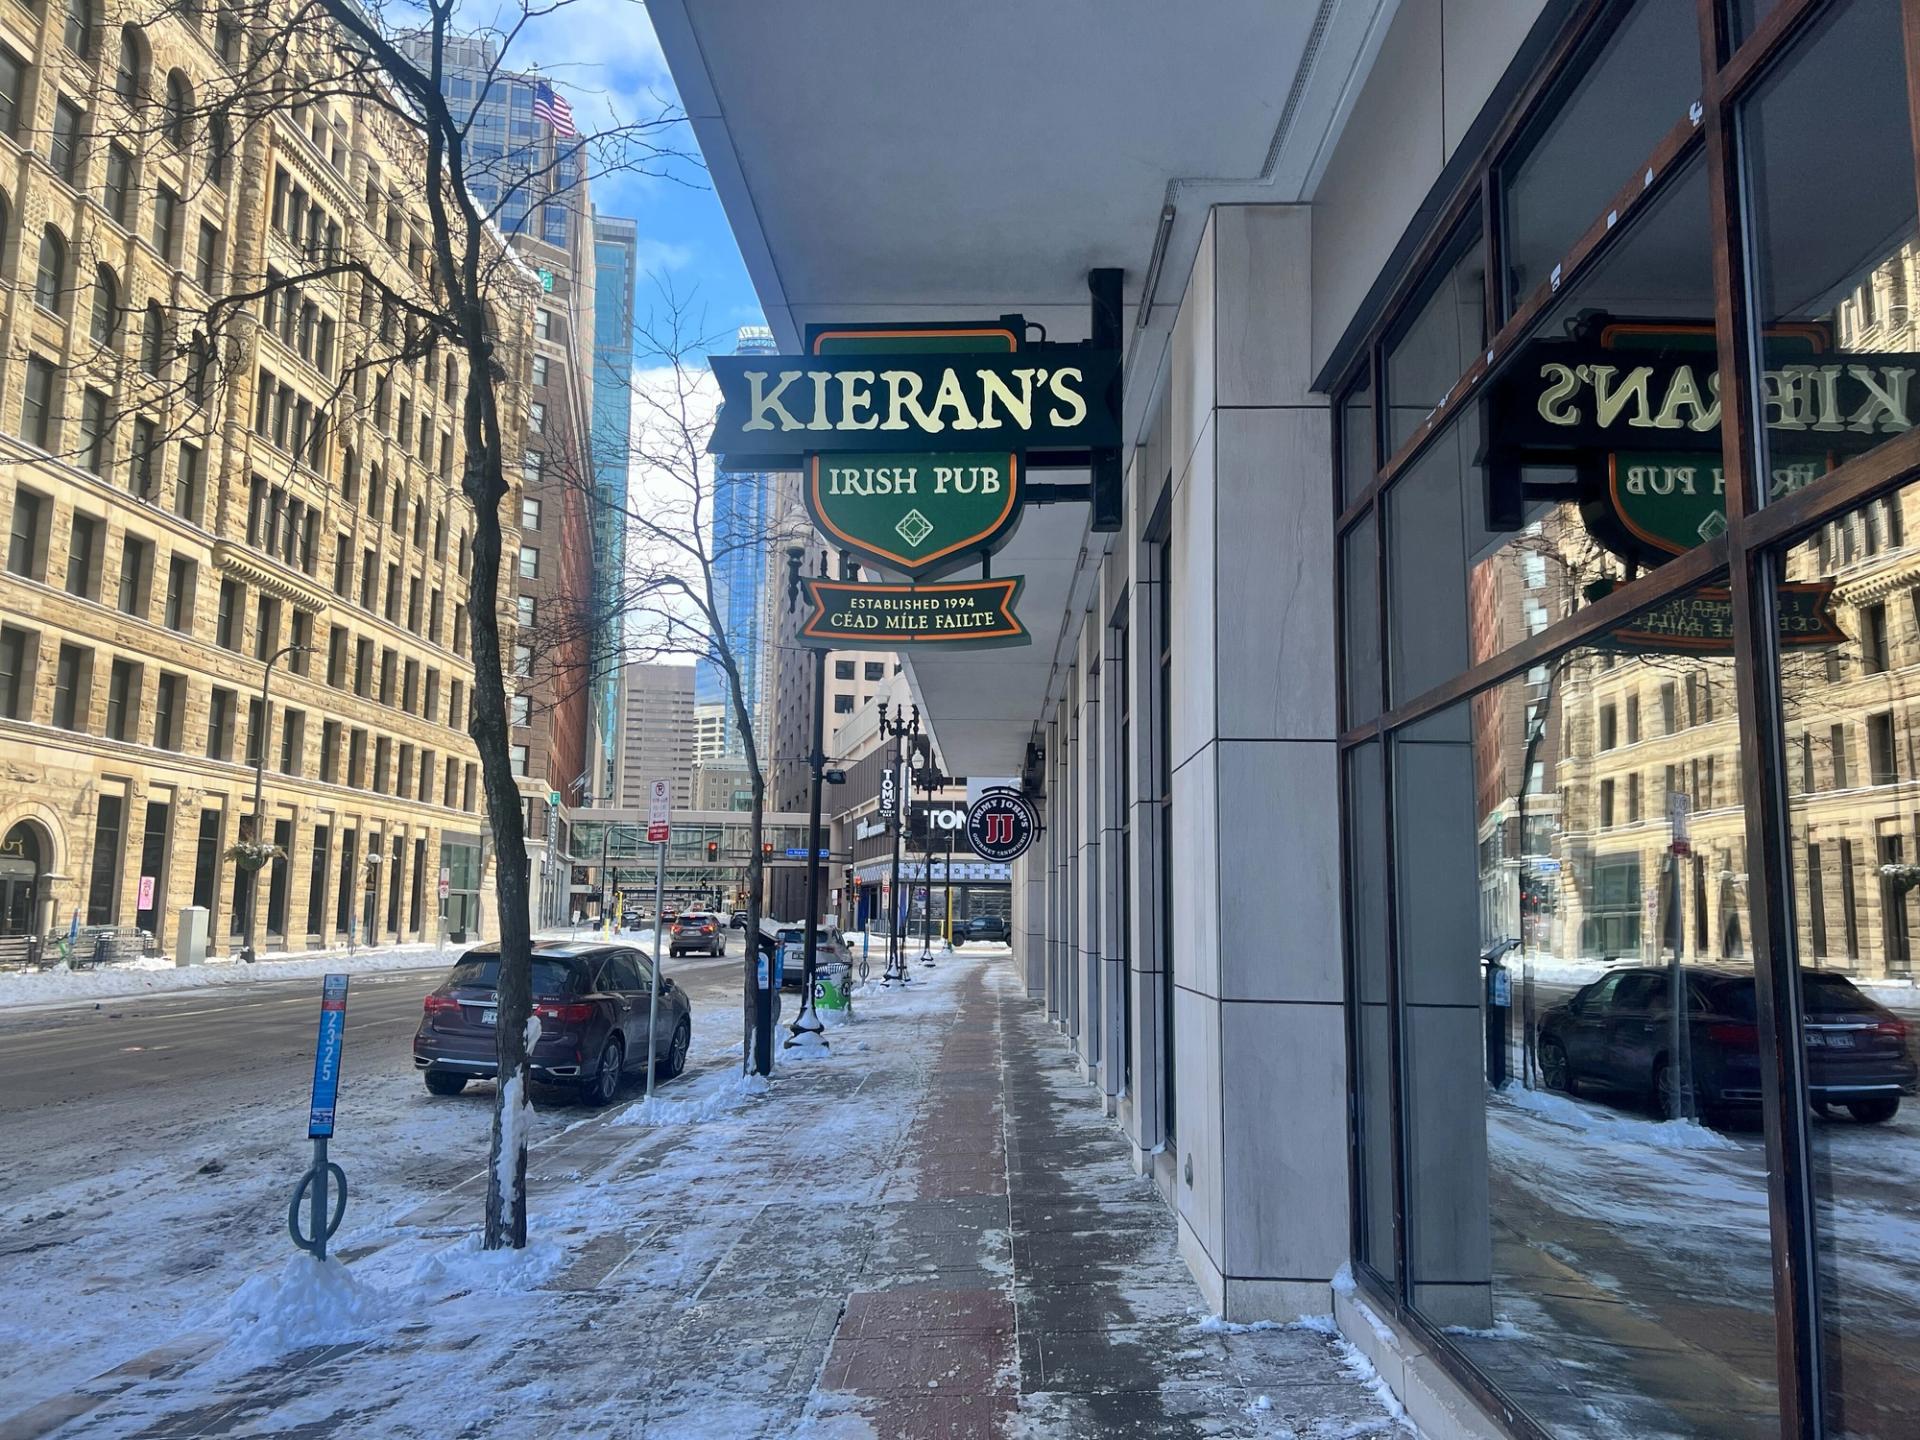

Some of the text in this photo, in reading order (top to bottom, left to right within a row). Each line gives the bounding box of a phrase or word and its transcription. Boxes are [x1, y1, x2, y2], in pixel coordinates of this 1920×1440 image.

[742, 367, 1087, 433] KIERAN'S
[829, 466, 1000, 496] IRISH PUB
[851, 597, 975, 610] ESTABLISHED 1994
[830, 611, 995, 629] CÉAD MÍLE FAILTE
[971, 799, 1029, 828] JIMMY JOHN'S
[972, 832, 996, 855] GOURMET
[986, 814, 1015, 844] JJ
[322, 1010, 337, 1081] 2325
